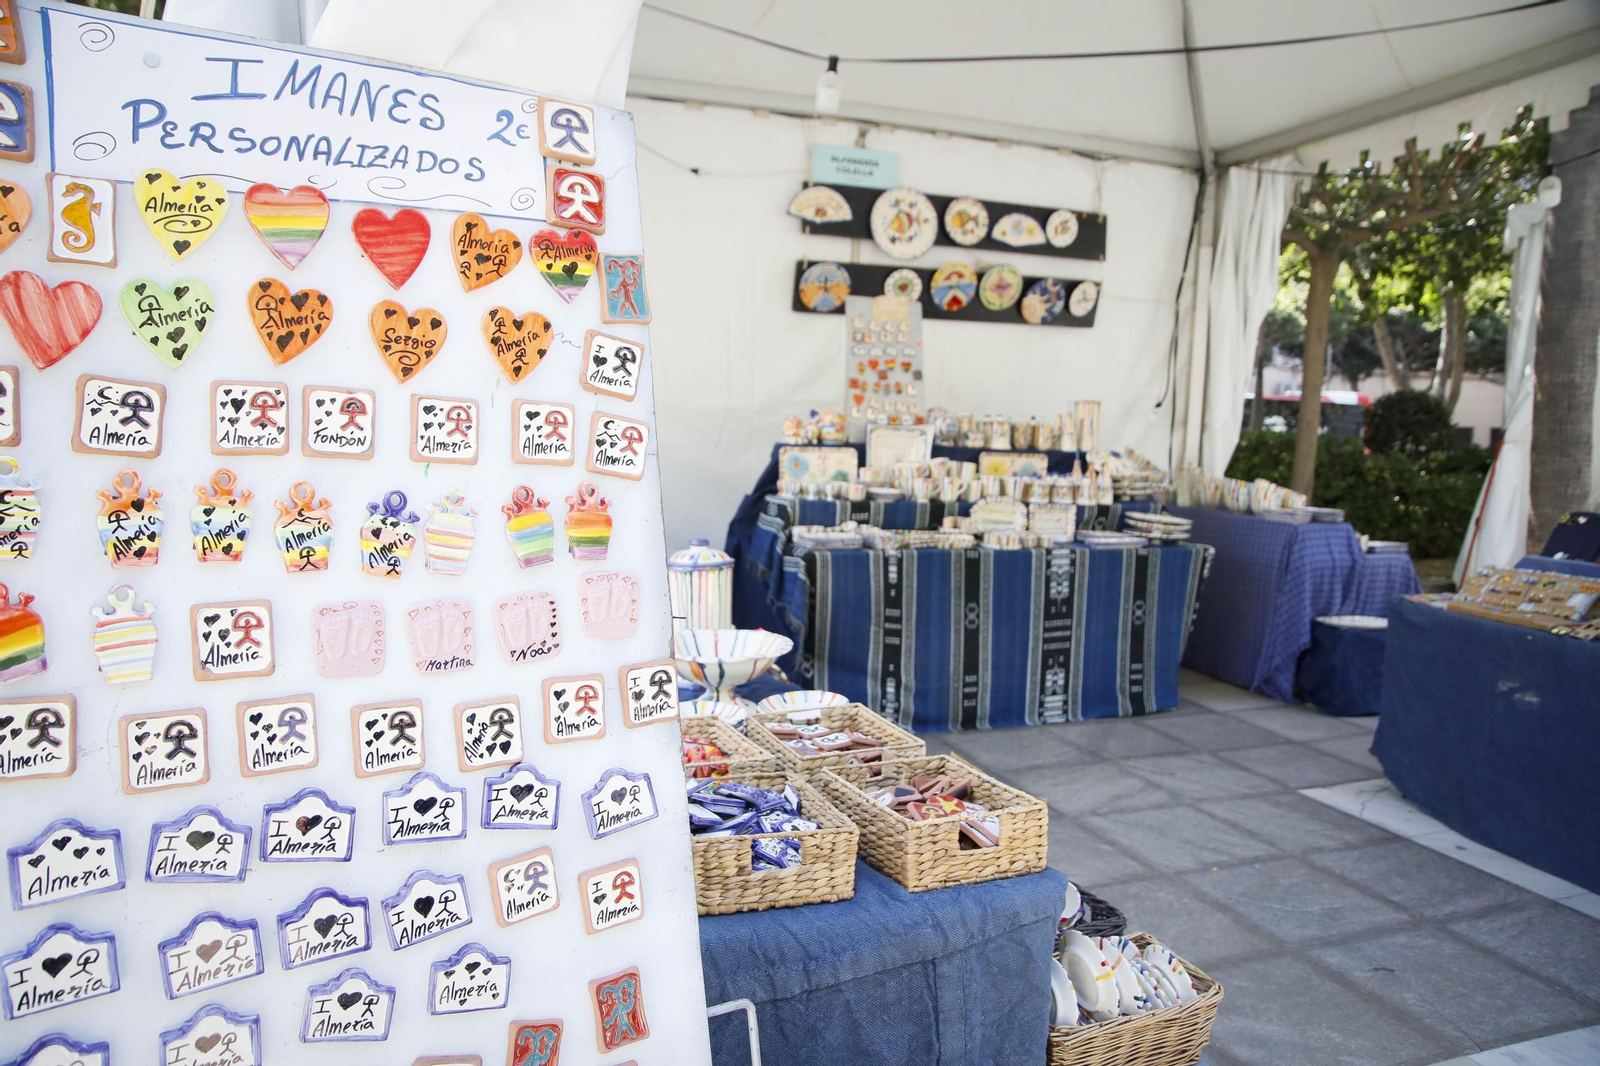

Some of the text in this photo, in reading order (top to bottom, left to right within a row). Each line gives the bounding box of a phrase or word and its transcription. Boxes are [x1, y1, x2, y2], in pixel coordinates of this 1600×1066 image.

[121, 98, 486, 182] PERSONALIZADOS
[145, 192, 214, 213] Almería
[457, 229, 510, 253] Almería
[497, 330, 540, 357] Almería
[595, 344, 605, 354] I
[589, 369, 632, 388] Almería
[89, 422, 153, 446] Almería
[218, 429, 280, 446] Almería
[313, 426, 367, 448] FONDÓN
[421, 439, 472, 453] Almería
[523, 437, 569, 457] Almería
[595, 450, 636, 467] Almería
[113, 514, 161, 561] Almería
[201, 510, 250, 556] Almería
[285, 517, 333, 553] Almería
[203, 642, 263, 668] Almería
[515, 642, 552, 662] Noa
[629, 676, 641, 690] I
[633, 699, 675, 722] Almería
[556, 715, 602, 737] Almería
[252, 742, 309, 769] Almería
[365, 746, 418, 769] Almería
[136, 760, 197, 786] Almería
[488, 788, 507, 803] I
[388, 807, 407, 825] I
[492, 804, 549, 822] Almería
[593, 801, 608, 818] I
[597, 806, 643, 831] Almería
[269, 820, 290, 837] I
[392, 818, 451, 839] Almería
[157, 836, 181, 852] I
[268, 838, 337, 857] Almería
[155, 854, 228, 875] Almería
[28, 865, 110, 900] Almería
[592, 881, 604, 894] I
[506, 890, 552, 920] Almería
[597, 902, 640, 925] Almería
[391, 910, 406, 925] I
[400, 911, 462, 945] Almería
[288, 923, 307, 946] I
[293, 935, 359, 963] Almería
[169, 950, 190, 975] I
[177, 956, 255, 991] Almería
[10, 967, 32, 987] I
[17, 977, 109, 1011] Almería
[440, 977, 498, 1003] Almería
[314, 999, 332, 1014] I
[312, 1017, 374, 1037] Almería
[168, 1043, 189, 1065] I
